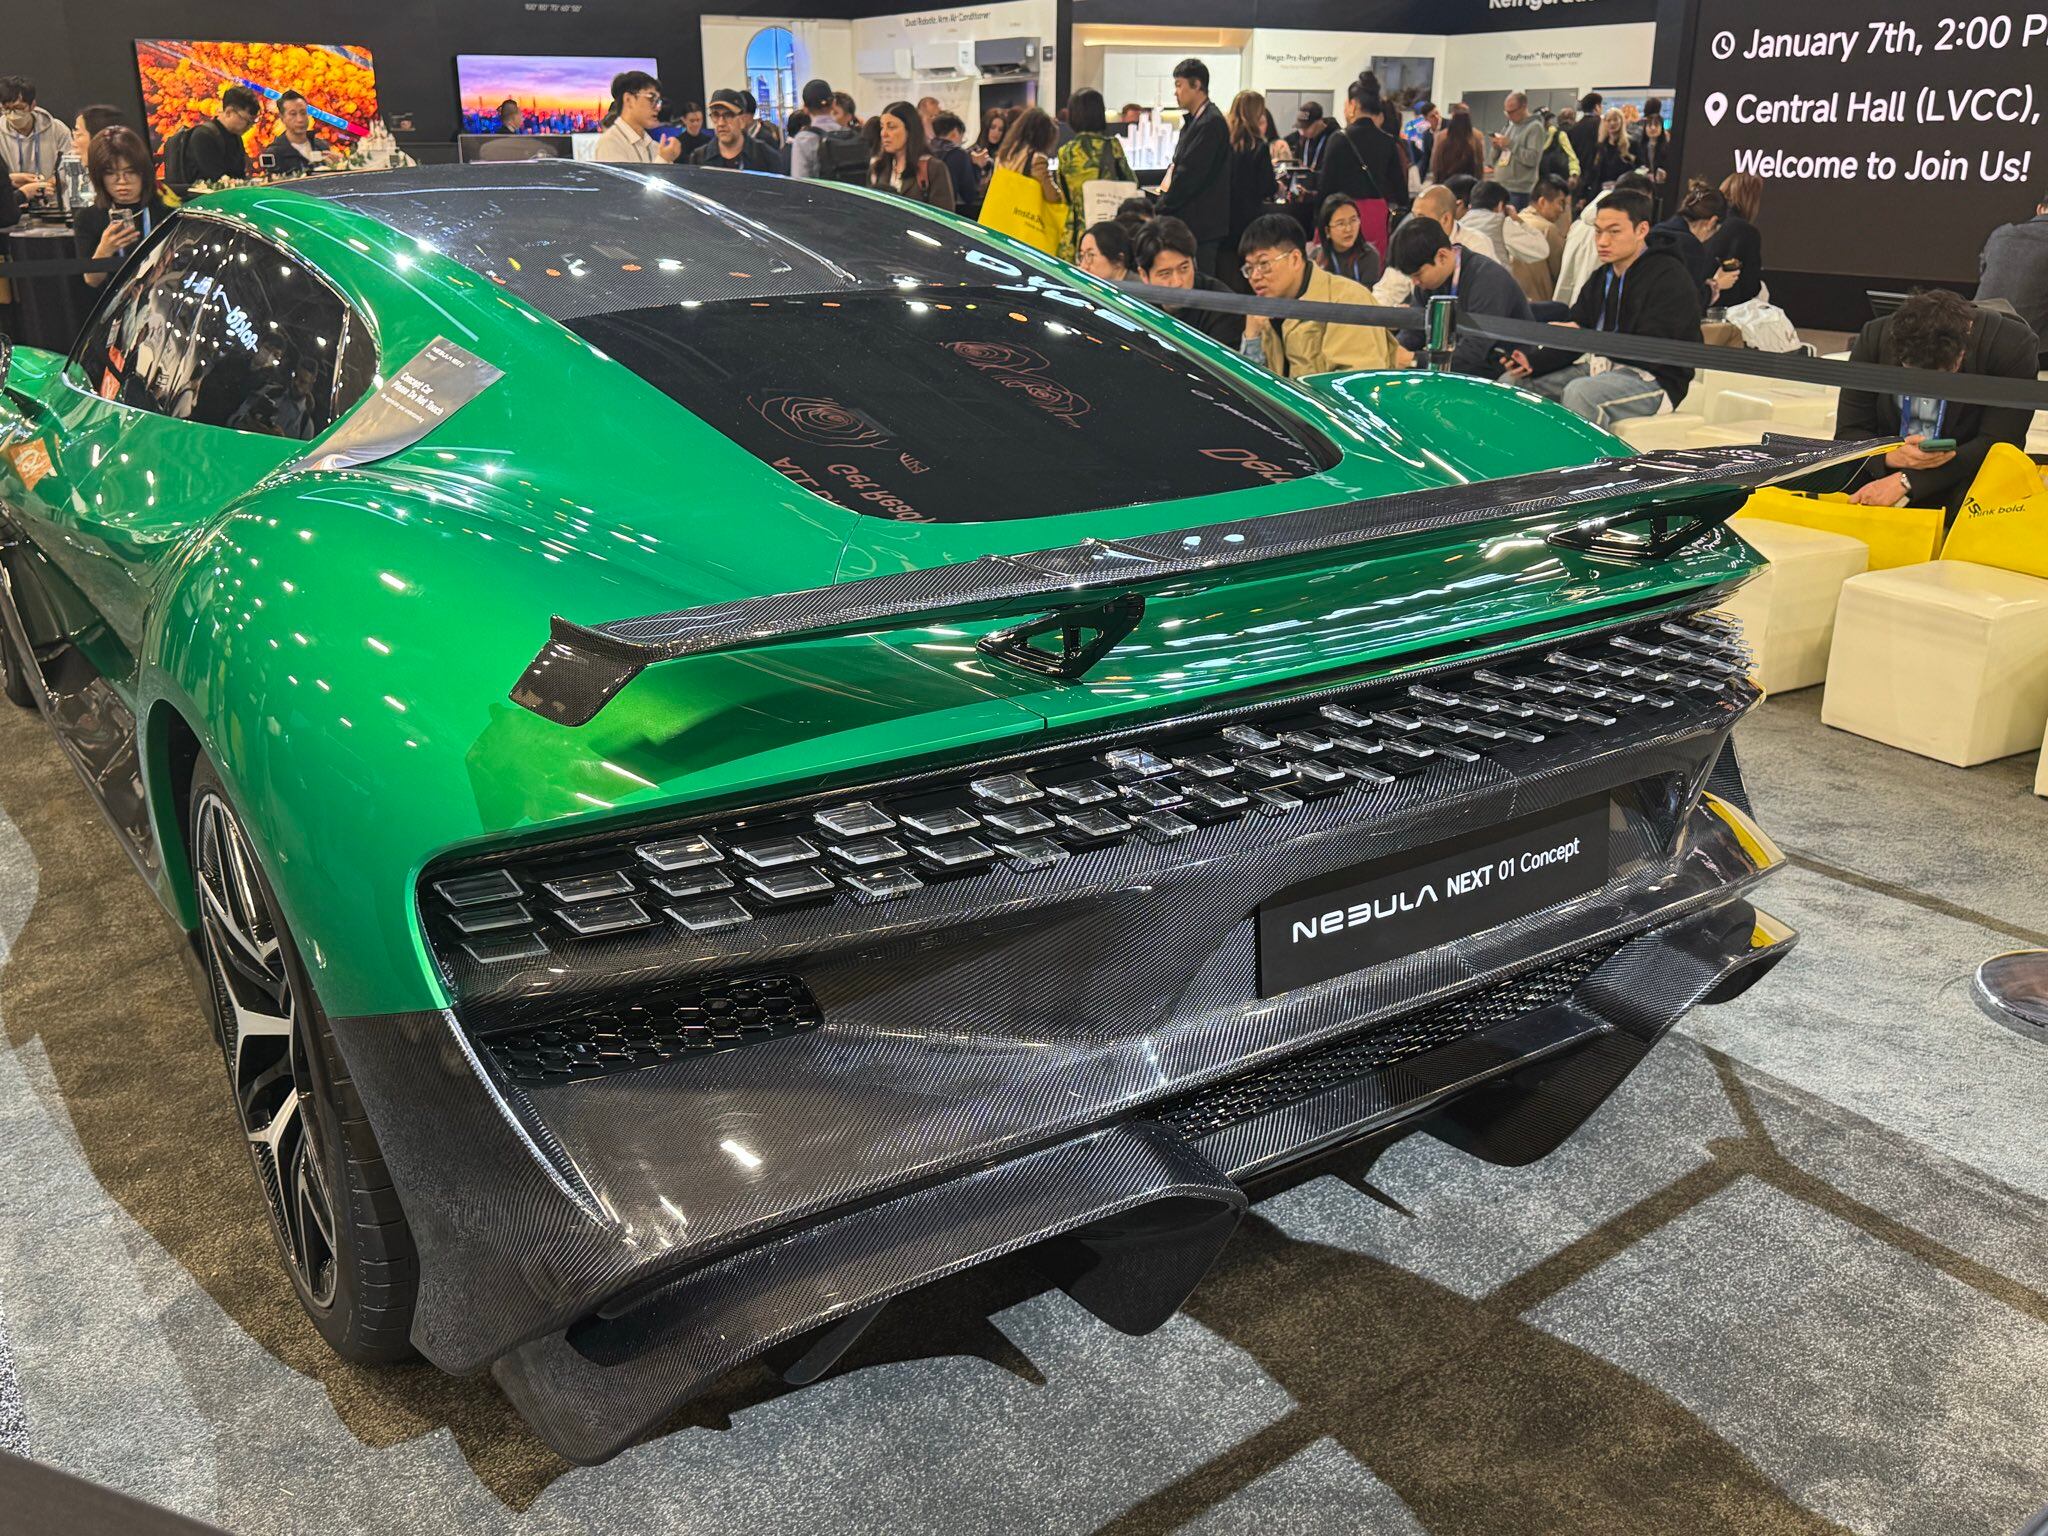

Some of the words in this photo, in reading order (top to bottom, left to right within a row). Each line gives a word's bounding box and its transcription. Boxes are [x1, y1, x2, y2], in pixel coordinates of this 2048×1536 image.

[1488, 0, 1599, 11] Refrige
[1743, 28, 1858, 62] January
[1866, 21, 1923, 56] 7th,
[1934, 15, 2012, 50] 2:00
[2022, 13, 2048, 47] P
[1735, 92, 1838, 124] Central
[1847, 90, 1906, 122] Hall
[1916, 84, 2041, 125] (LVCC),
[1734, 149, 1858, 179] Welcome
[1866, 151, 1896, 181] to
[1904, 150, 1968, 181] Join
[1979, 150, 2032, 182] Us!
[1446, 864, 1494, 899] NEXT
[1498, 857, 1516, 881] 01
[1520, 837, 1580, 873] Concept
